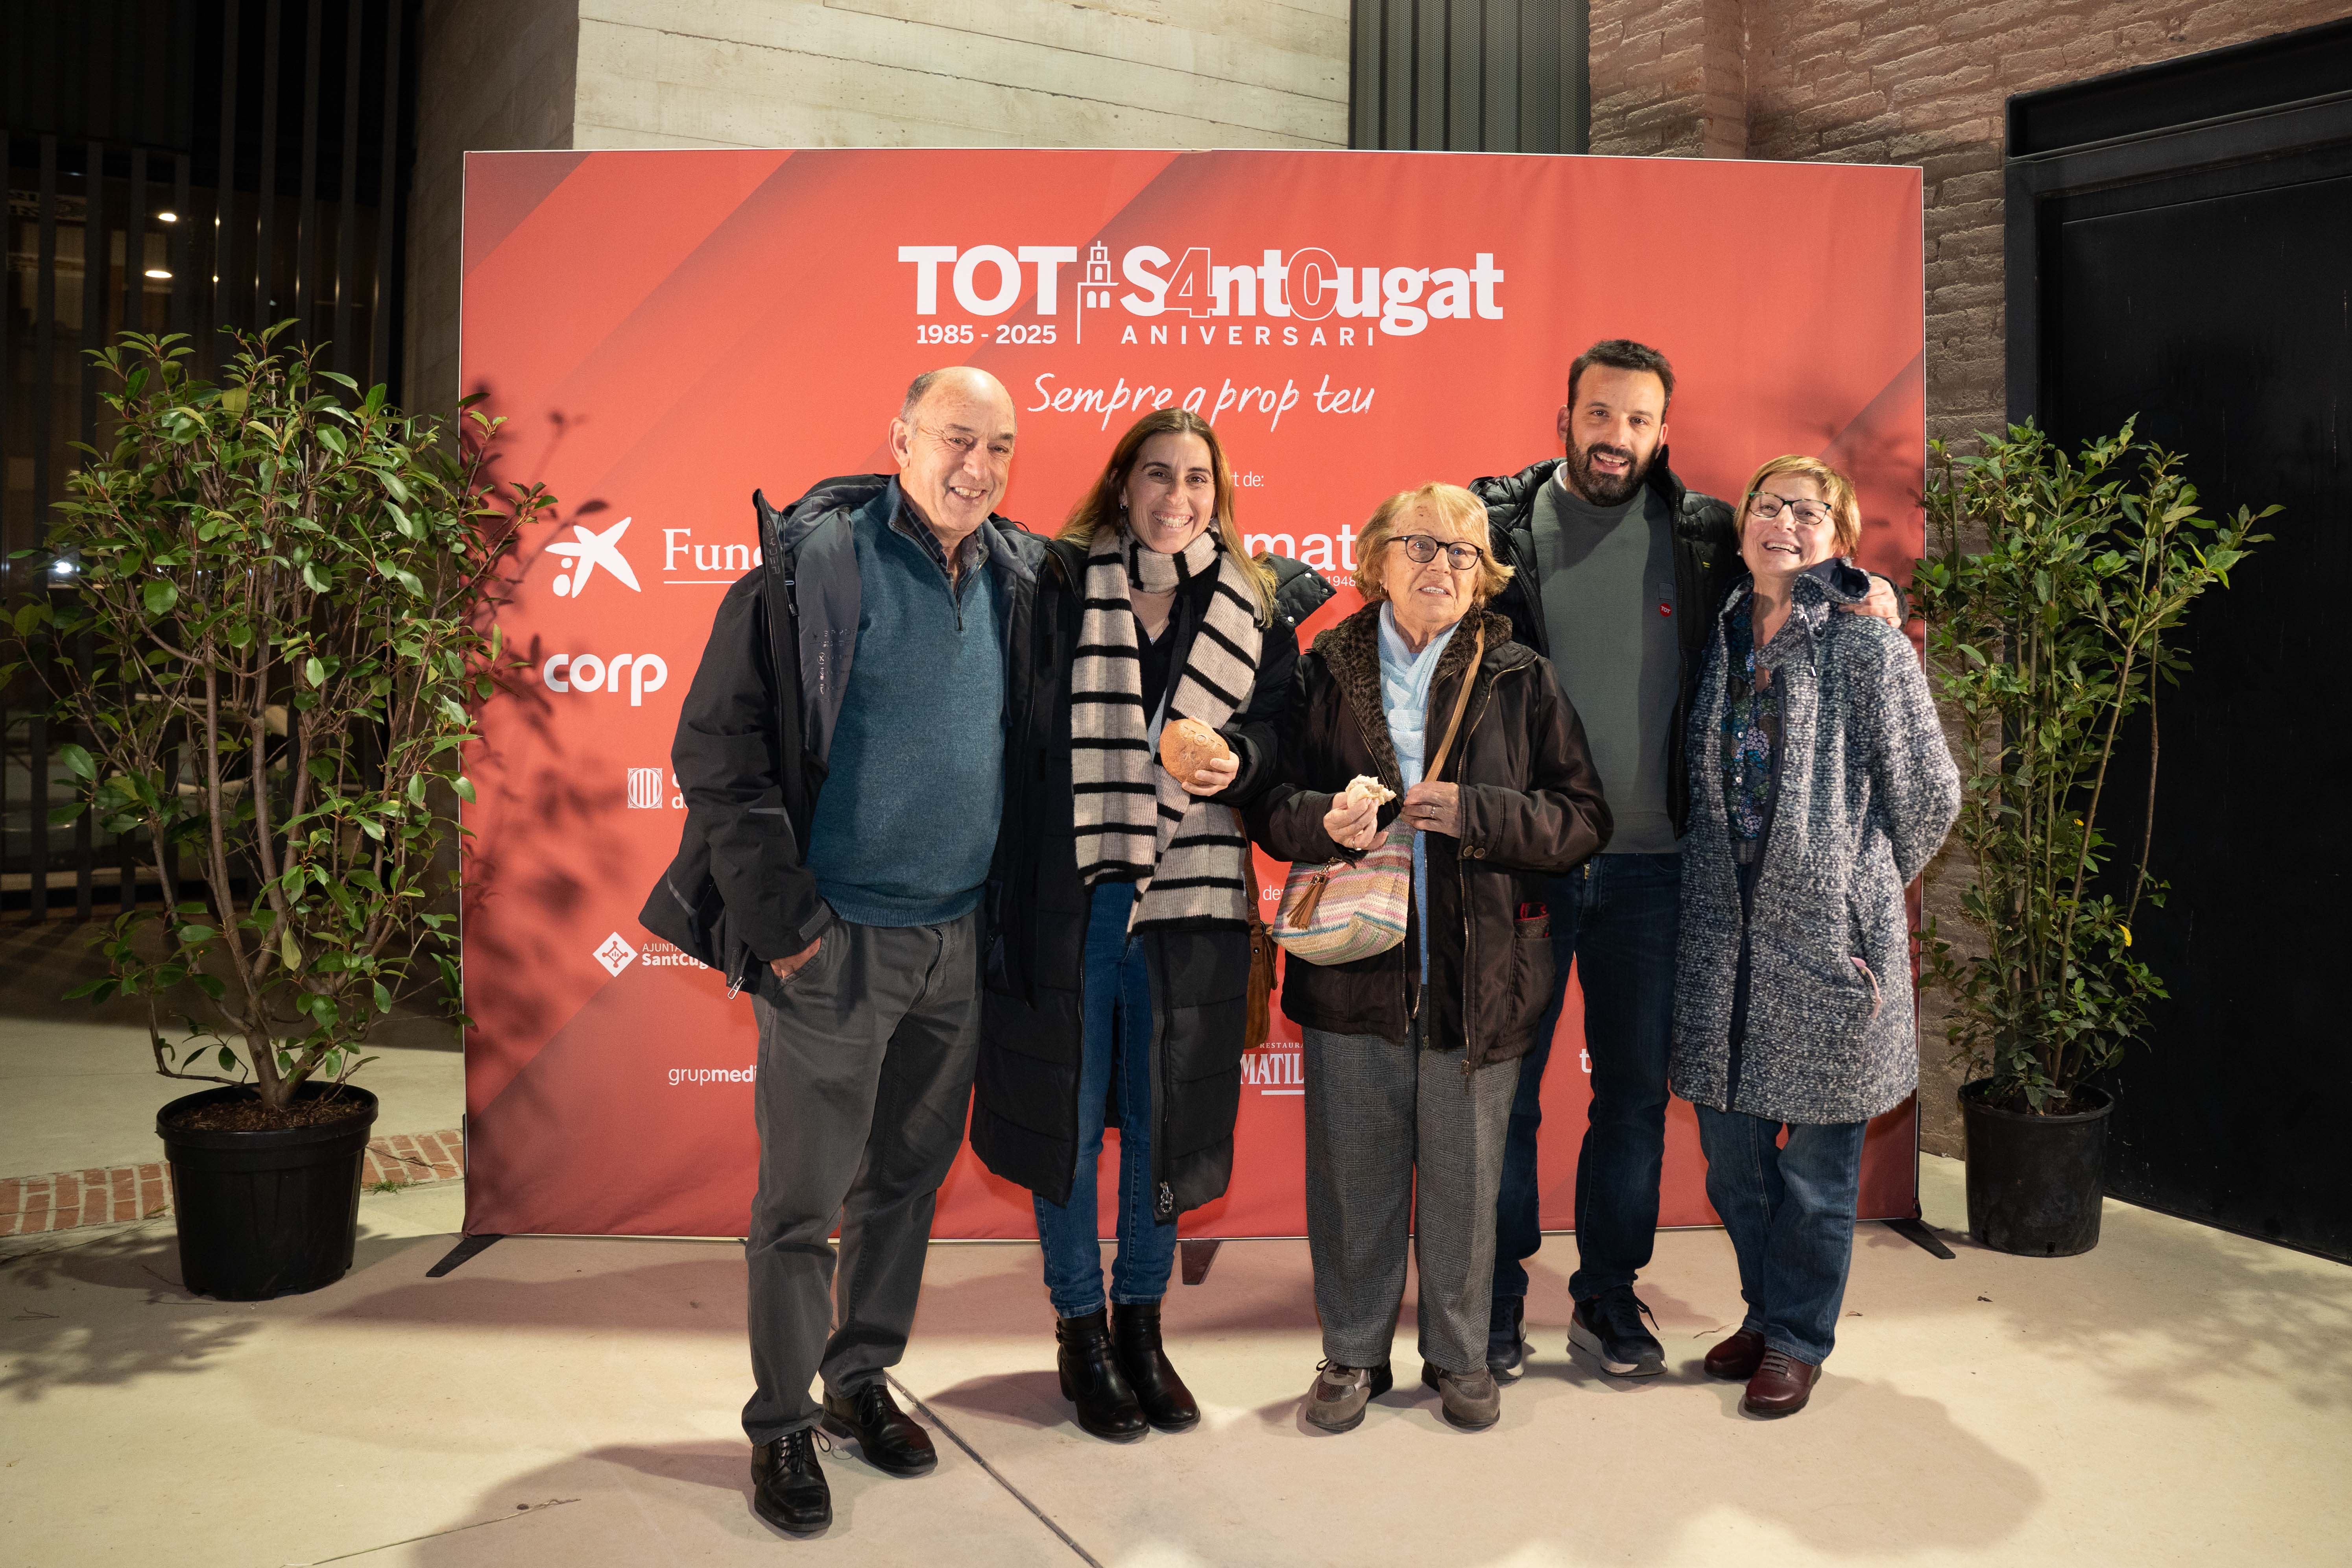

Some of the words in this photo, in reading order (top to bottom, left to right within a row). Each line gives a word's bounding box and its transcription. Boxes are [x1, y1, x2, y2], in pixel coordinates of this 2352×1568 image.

[899, 245, 1077, 316] TOT
[917, 324, 974, 344] 1985
[995, 324, 1057, 344] 2025
[1121, 325, 1374, 346] ANIVERSARI
[1027, 373, 1174, 431] Sempre
[1183, 387, 1206, 414] a
[1209, 378, 1300, 432] prop
[1313, 374, 1375, 414] teu
[1243, 471, 1264, 487] de:
[1326, 575, 1356, 586] 1948
[1661, 606, 1671, 614] TOT
[543, 653, 668, 707] corp
[1240, 1053, 1304, 1084] MATIL
